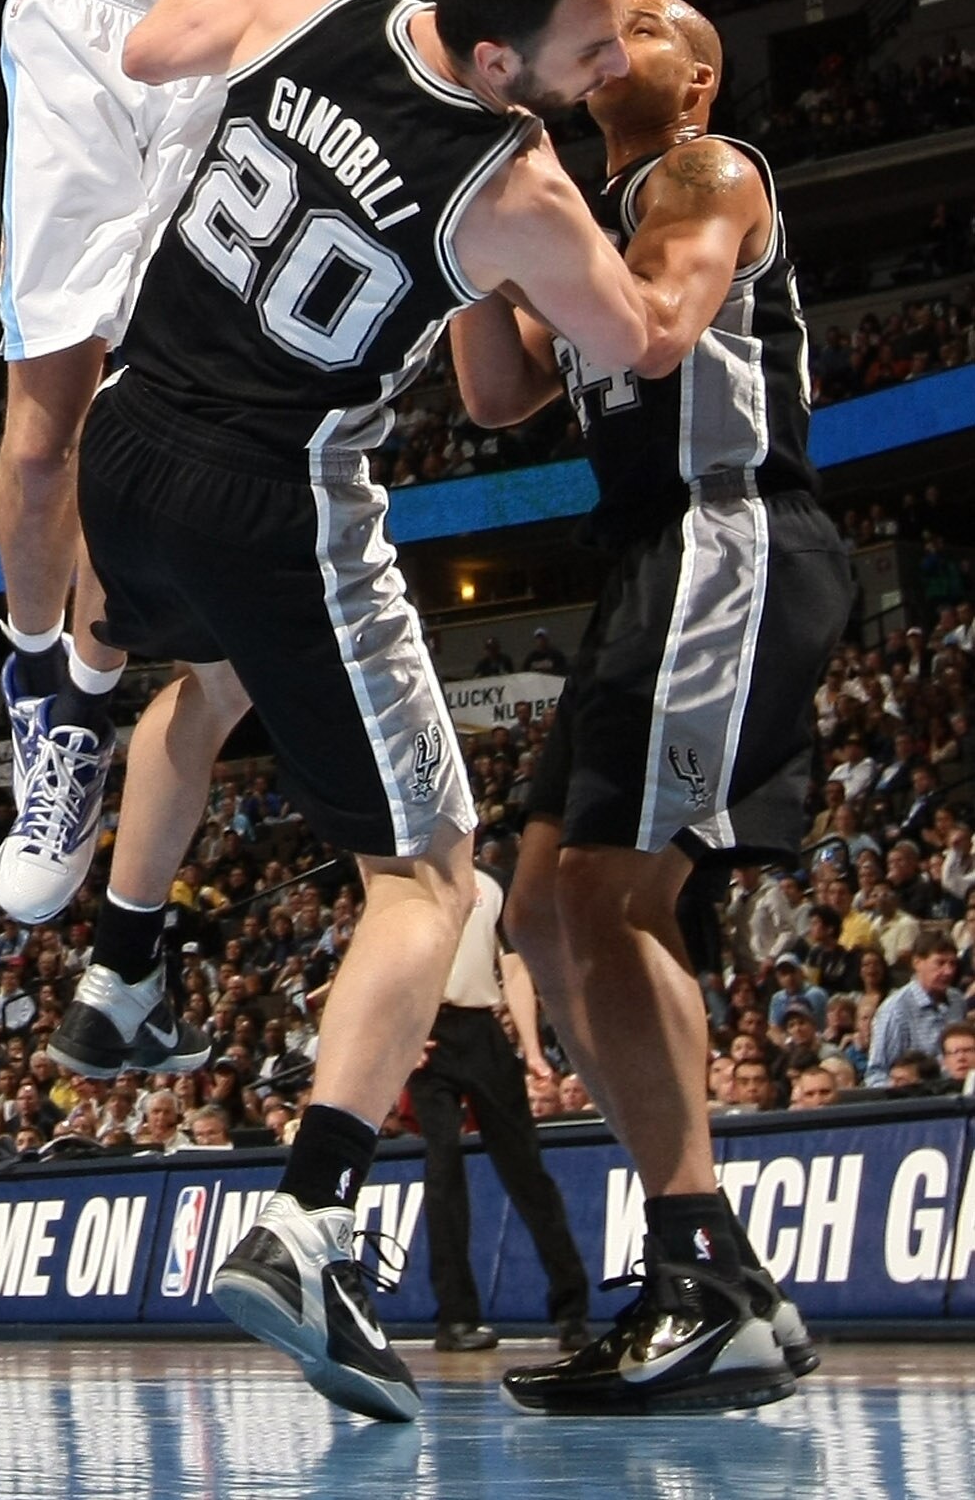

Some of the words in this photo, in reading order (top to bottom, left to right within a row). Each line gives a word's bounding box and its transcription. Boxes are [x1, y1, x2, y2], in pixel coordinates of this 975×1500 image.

[267, 76, 420, 231] GINOBILI
[177, 117, 413, 372] 20
[448, 686, 505, 709] LUCKY
[66, 1196, 147, 1297] ON
[603, 1154, 863, 1288] WTCH
